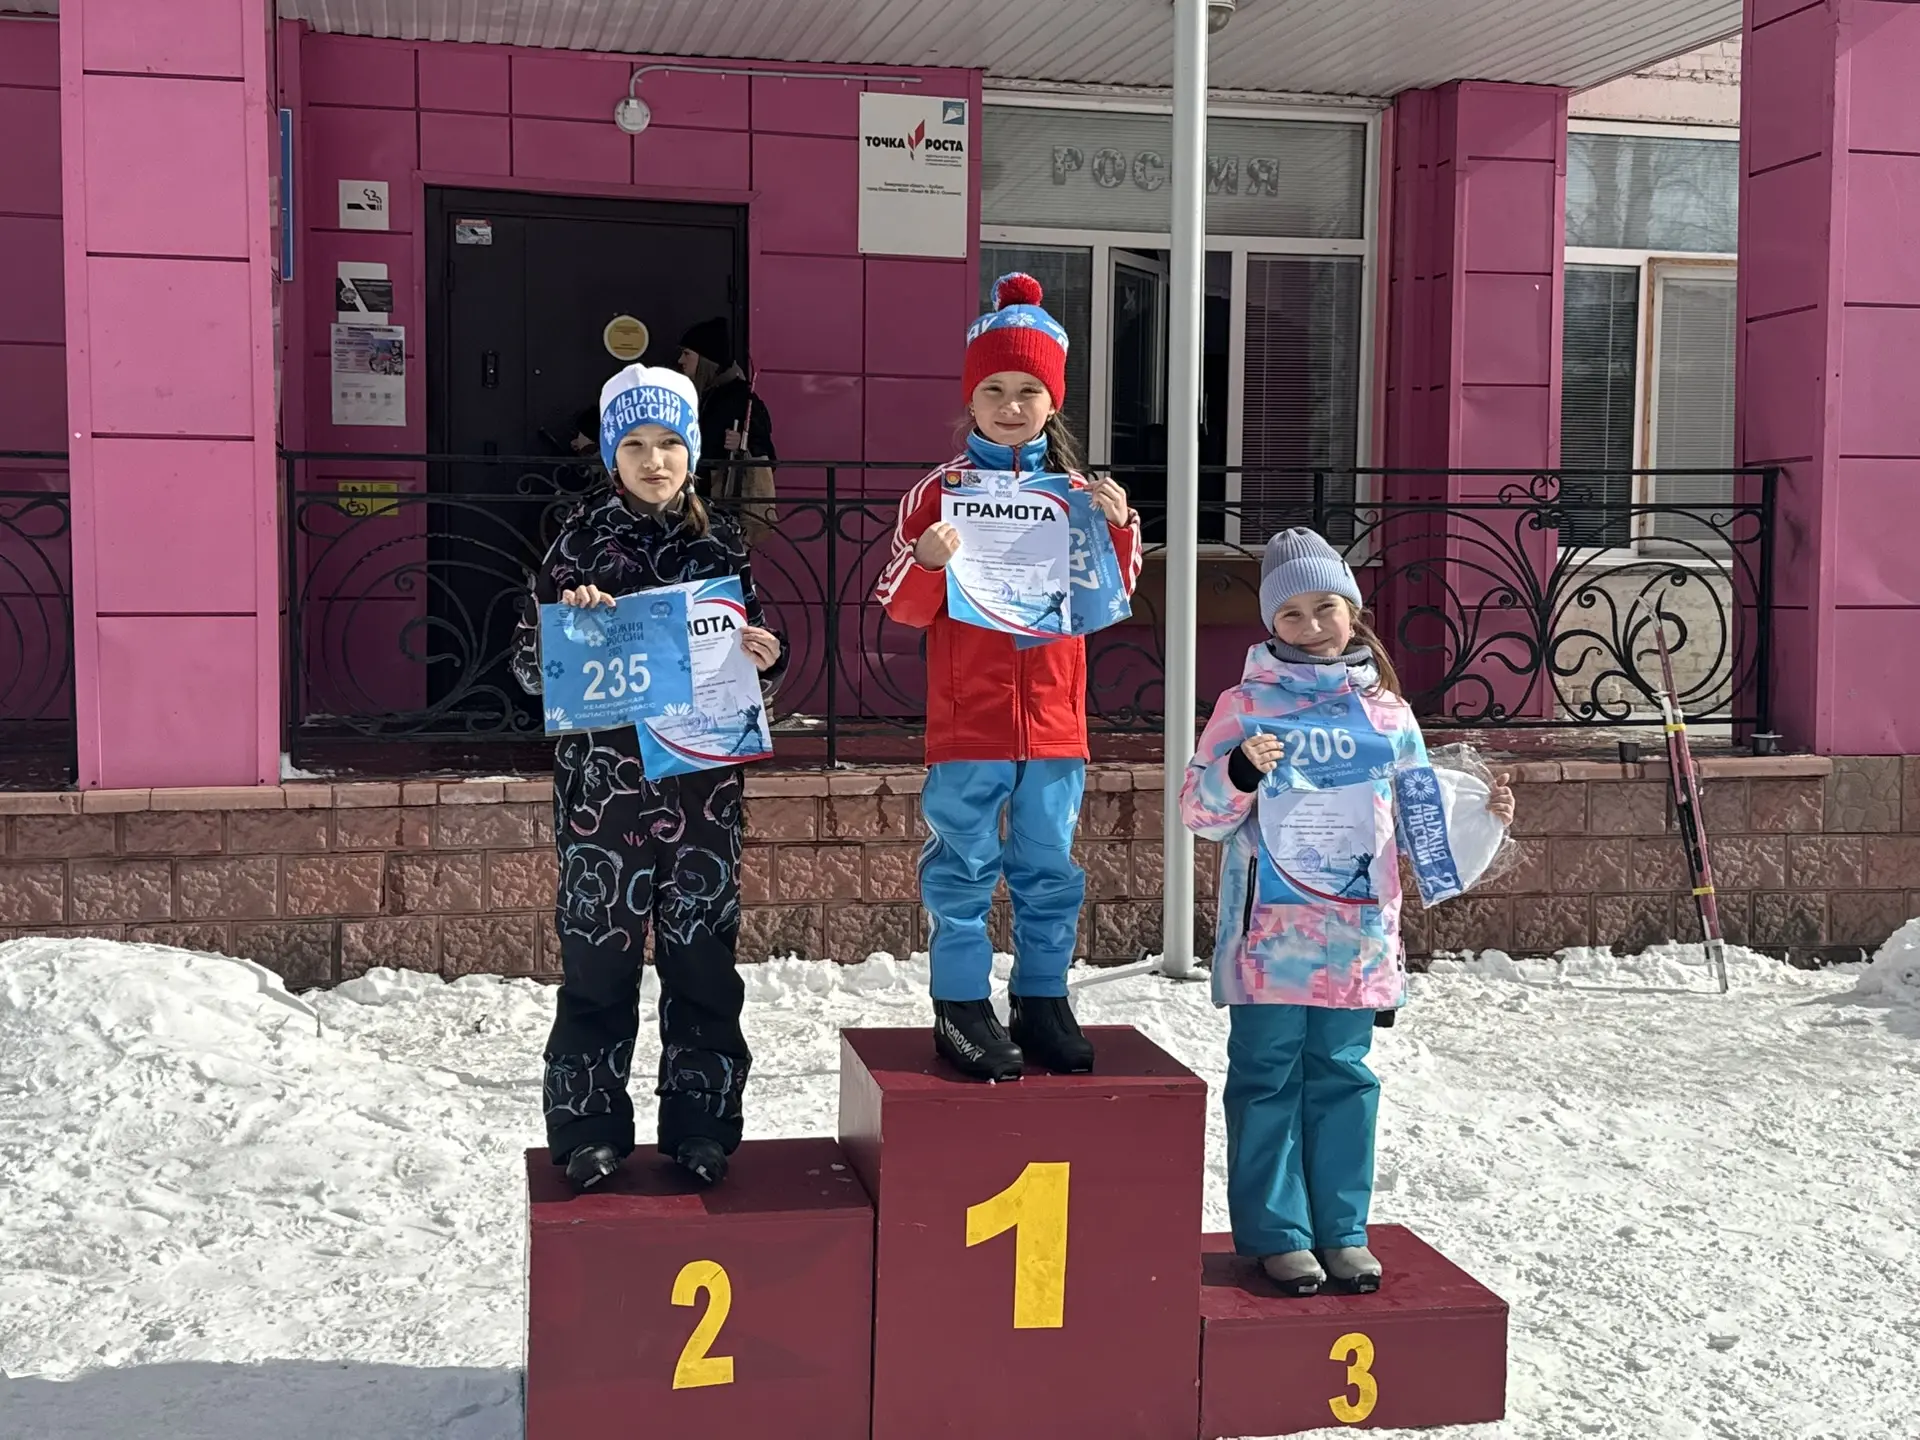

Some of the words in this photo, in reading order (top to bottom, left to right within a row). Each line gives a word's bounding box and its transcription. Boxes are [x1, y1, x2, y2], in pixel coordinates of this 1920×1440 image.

[865, 136, 906, 149] ТОЧКА
[925, 139, 964, 152] РОСТА
[1052, 145, 1280, 196] РОСИЯ
[615, 388, 681, 415] ЛЫЖНЯ
[616, 404, 681, 430] РОССИИ
[953, 502, 1056, 522] ГРАМОТА
[583, 653, 651, 701] 235
[1285, 727, 1357, 767] 206
[1407, 804, 1433, 866] РОССИИ
[1423, 803, 1449, 862] ЛЫЖНЯ
[945, 1017, 984, 1062] NORDWAY
[966, 1162, 1069, 1328] 1
[671, 1260, 734, 1389] 2
[1329, 1333, 1377, 1423] 3
